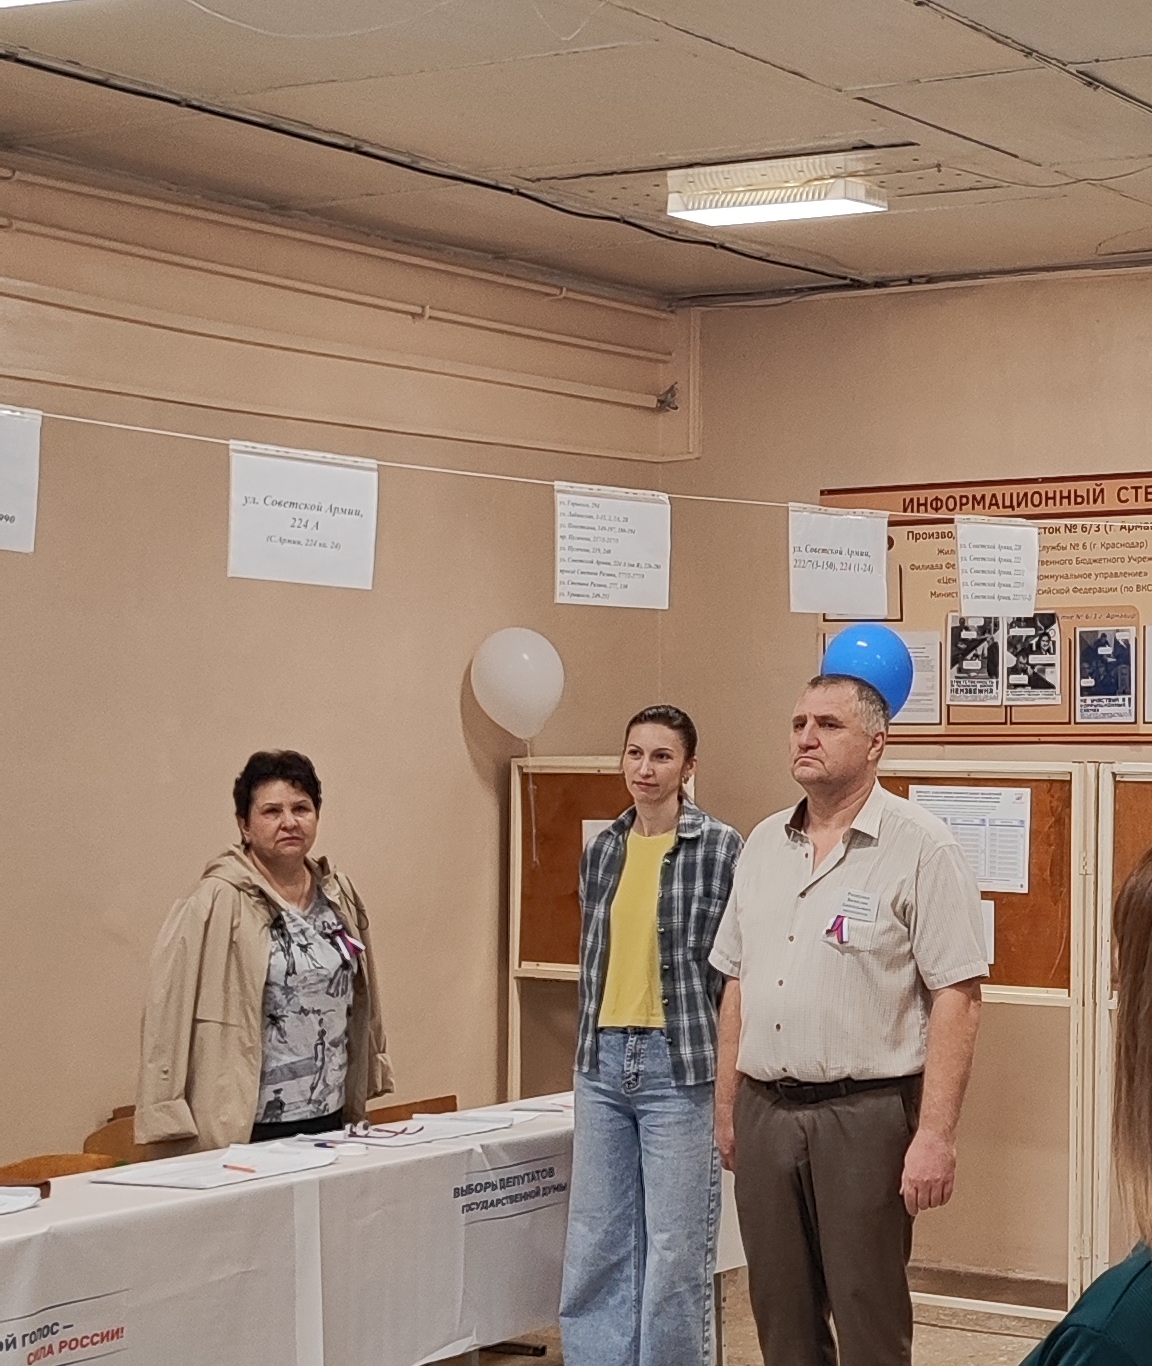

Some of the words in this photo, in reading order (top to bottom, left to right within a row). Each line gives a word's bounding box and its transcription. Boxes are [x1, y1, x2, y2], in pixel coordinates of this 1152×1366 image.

[902, 482, 1106, 514] ИНФОРМАЦИОННЫЙ
[242, 496, 259, 506] ул.
[263, 495, 323, 512] Советской
[325, 503, 363, 518] Армии,
[290, 517, 309, 530] 224
[906, 530, 956, 543] Произво
[1064, 523, 1078, 534] №
[1080, 523, 1100, 535] 6/3
[804, 543, 843, 556] Советской
[1069, 542, 1080, 551] №
[1082, 542, 1088, 550] 6
[1100, 540, 1148, 552] Краснодар)
[1075, 556, 1125, 566] Бюджетного
[1037, 572, 1093, 582] оммунальное
[1094, 570, 1149, 581] управление»
[1036, 585, 1070, 595] сийской
[1072, 585, 1117, 595] Федерации
[1120, 584, 1134, 594] (по
[499, 1167, 555, 1190] ДЕПУТАТОВ
[541, 1182, 567, 1197] ДУМЫ
[21, 1322, 60, 1347] ГОЛОС
[27, 1343, 55, 1366] СИЛА
[58, 1326, 125, 1354] РОССИИ!
